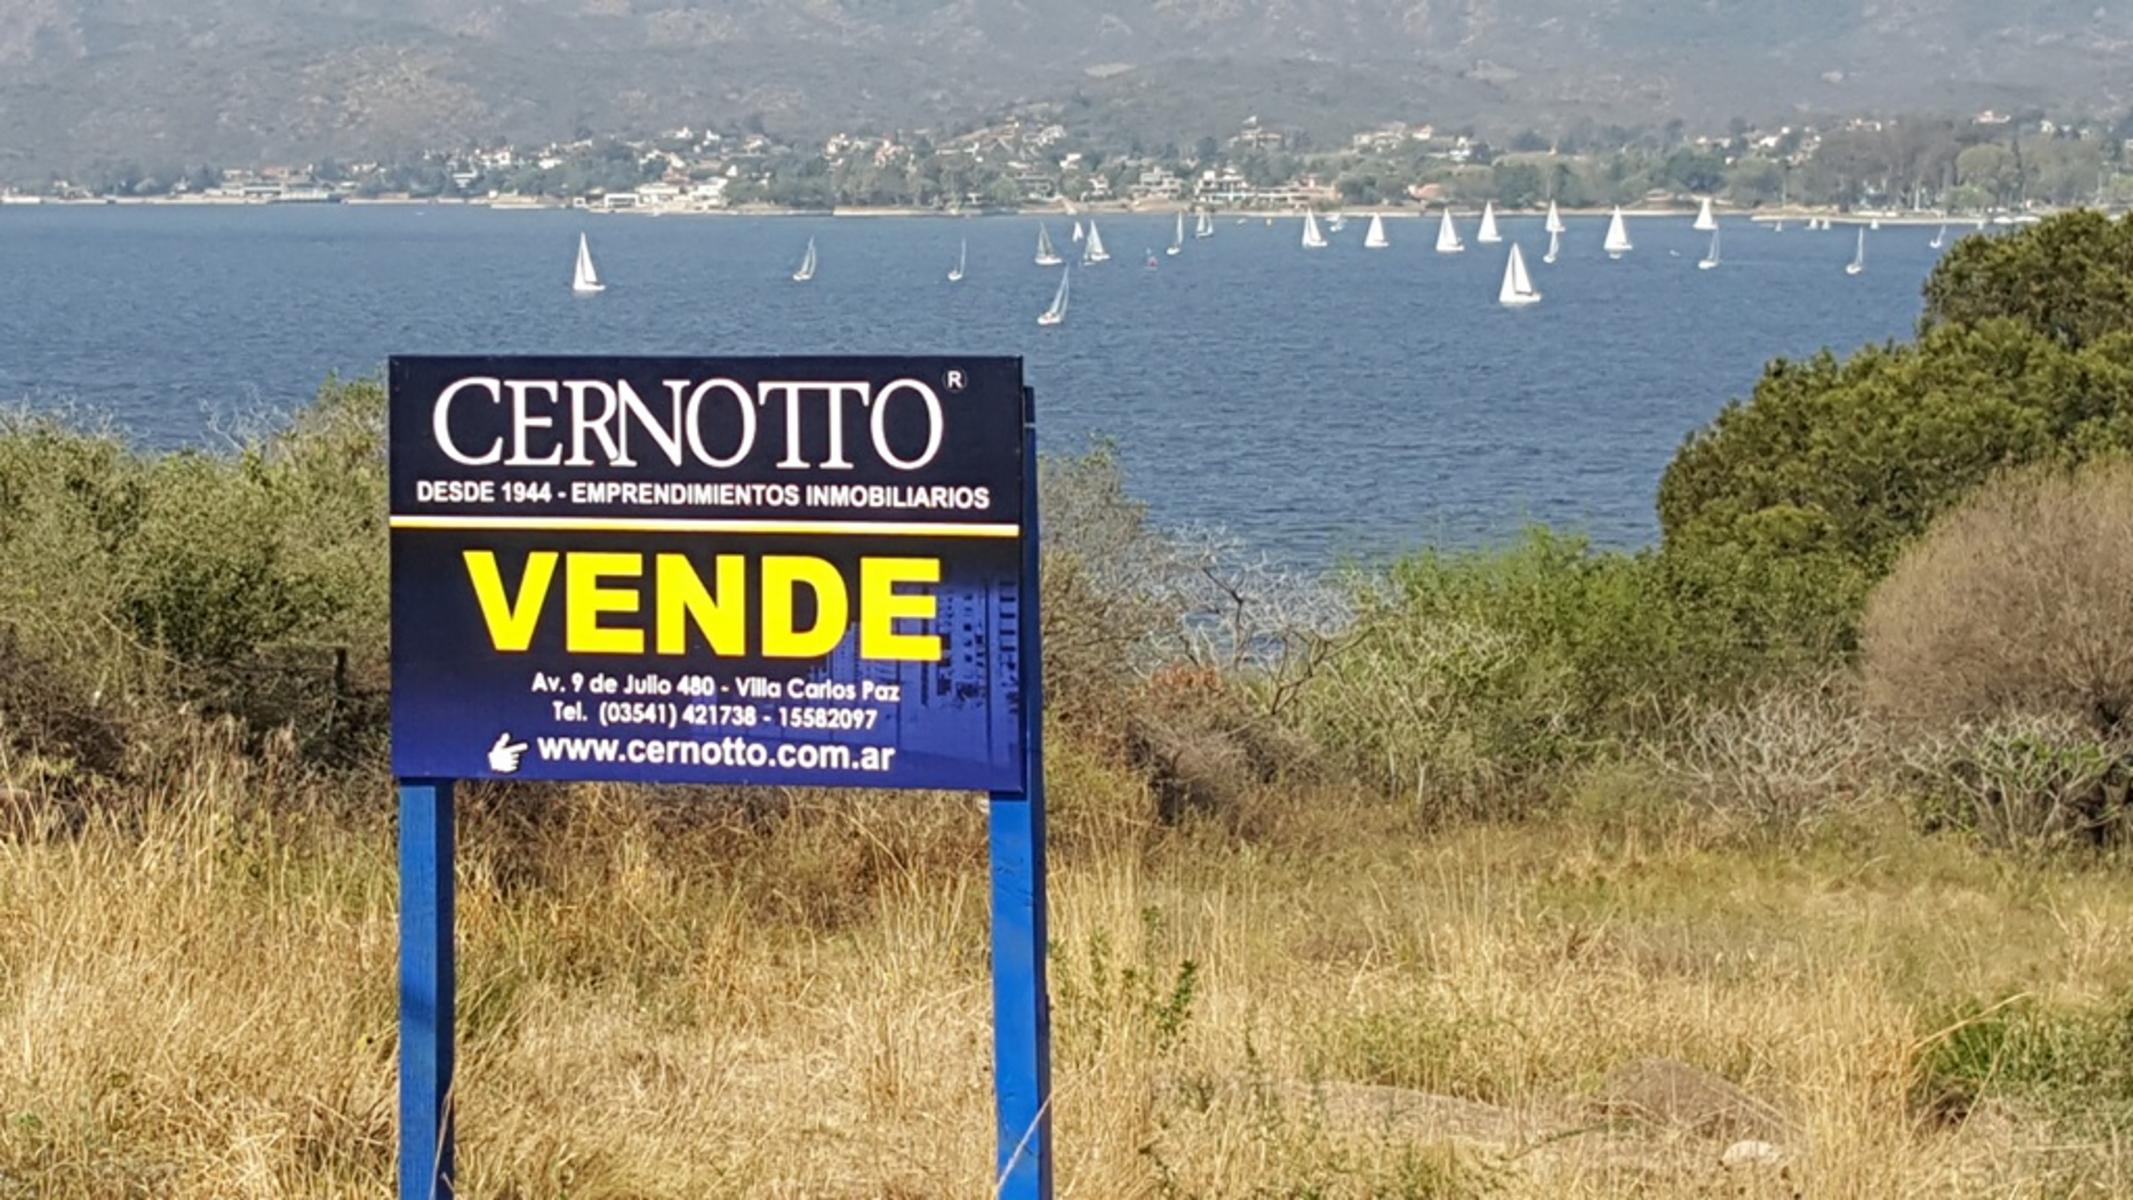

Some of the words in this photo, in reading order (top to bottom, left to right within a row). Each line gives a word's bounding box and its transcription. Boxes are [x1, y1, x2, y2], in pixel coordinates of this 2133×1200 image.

[433, 377, 944, 469] CERNOTTO
[417, 481, 494, 502] DESDE
[502, 482, 552, 502] 1944
[572, 482, 800, 506] EMPRENDIMIENTOS
[806, 485, 989, 509] INMOBILIARIOS
[463, 551, 942, 661] VENDE
[532, 672, 565, 692] Av.
[572, 673, 583, 692] 9
[590, 673, 617, 693] de
[624, 674, 671, 695] Julio
[677, 675, 715, 696] 480
[735, 677, 781, 698] Villa
[787, 678, 856, 700] Carlos
[862, 680, 900, 702] Paz
[553, 701, 587, 721] Tel.
[600, 702, 677, 729] (03541)
[682, 704, 757, 726] 421738
[779, 707, 878, 729] 15582097
[537, 735, 896, 771] www.cernotto.com.ar
